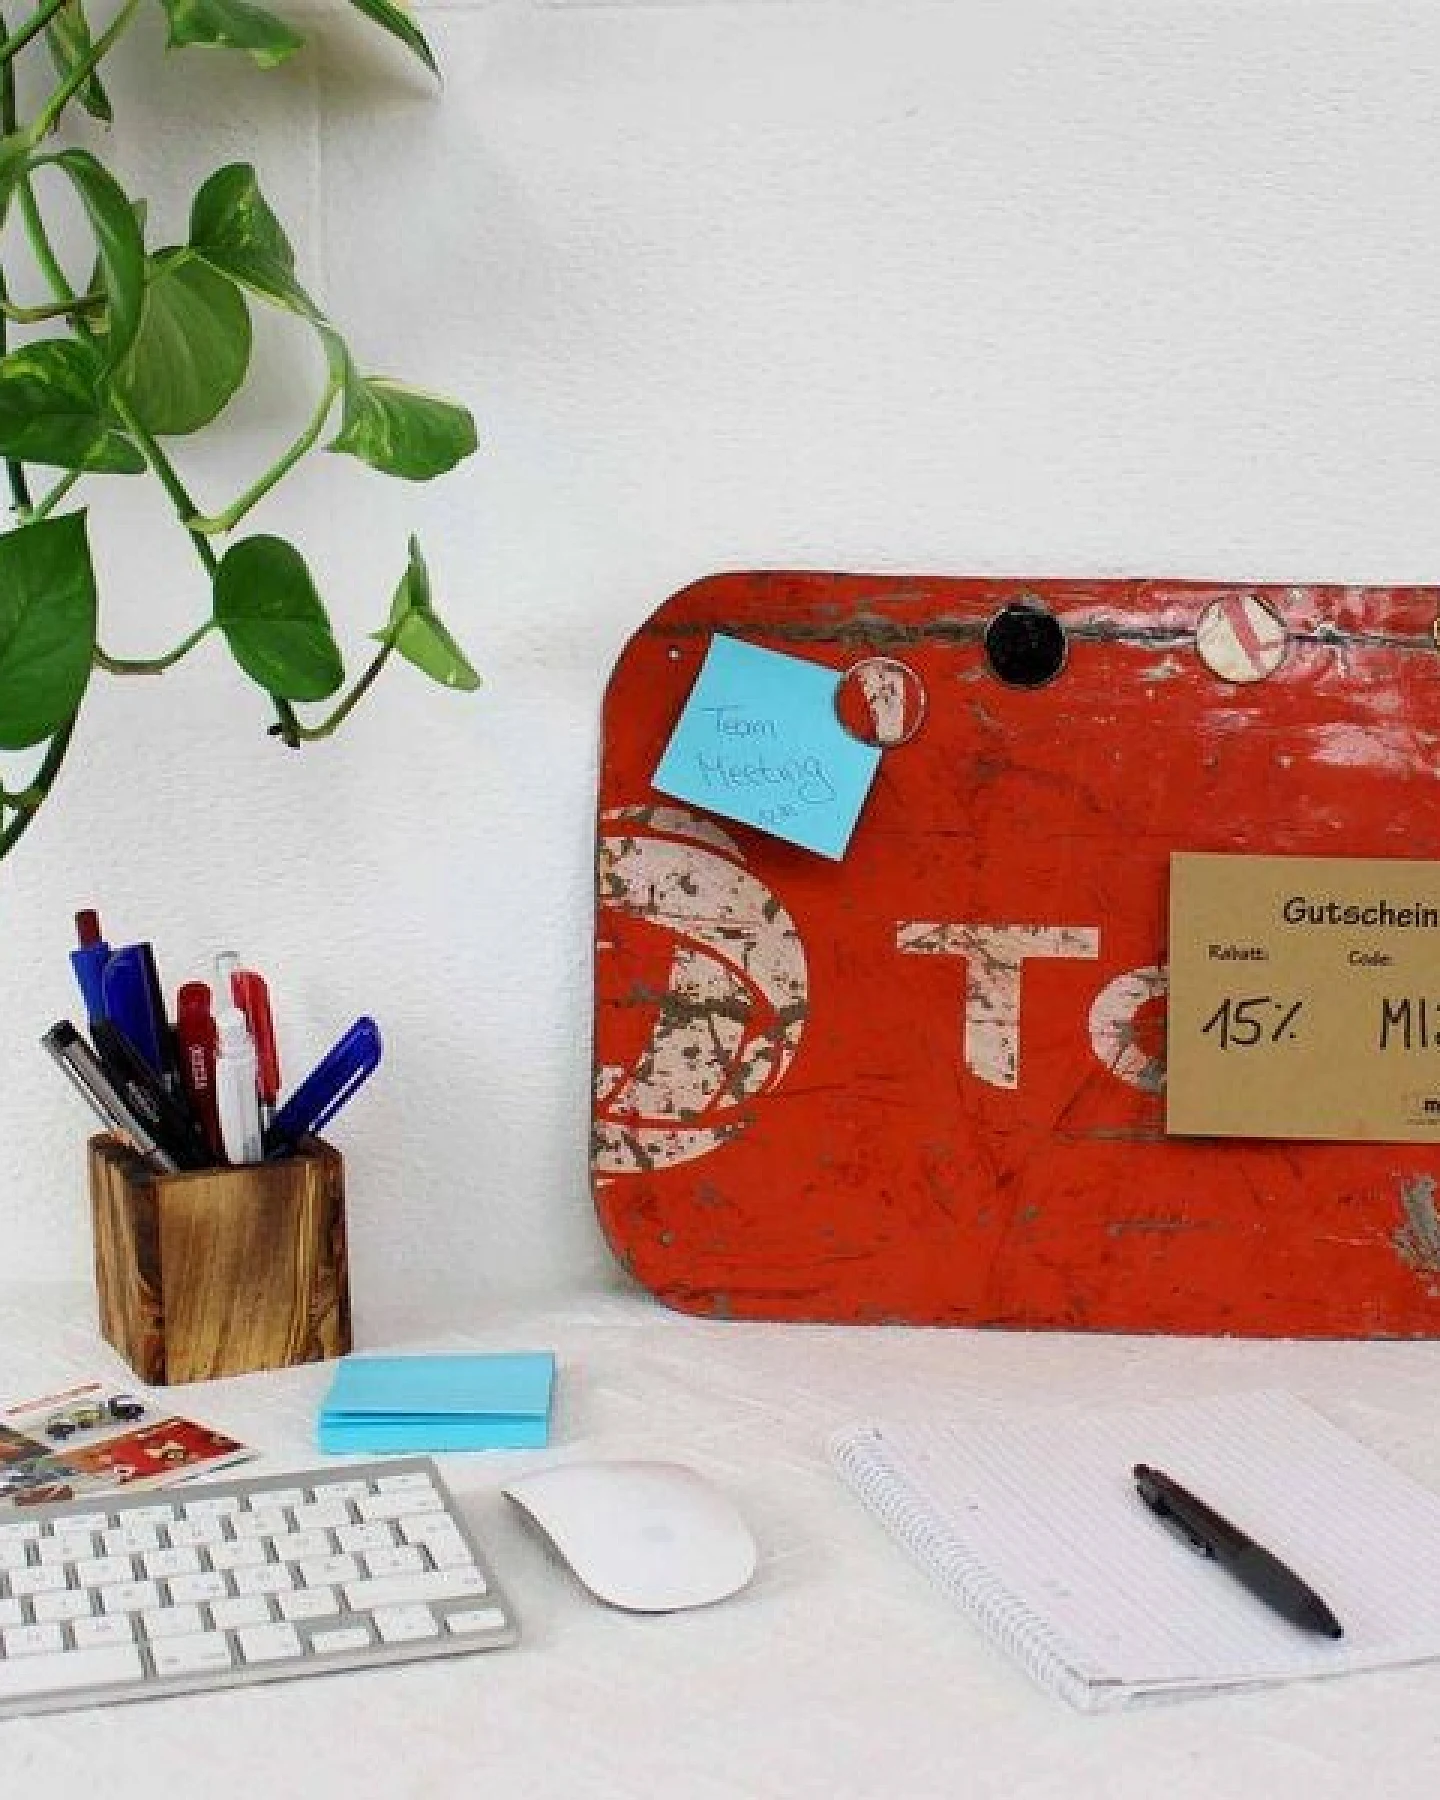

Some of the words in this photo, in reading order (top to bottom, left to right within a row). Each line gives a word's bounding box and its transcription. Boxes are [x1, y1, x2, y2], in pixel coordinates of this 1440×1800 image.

[701, 705, 777, 738] Team
[698, 753, 836, 804] Meeting
[1283, 897, 1438, 928] Gutschein
[1202, 996, 1303, 1050] 15%
